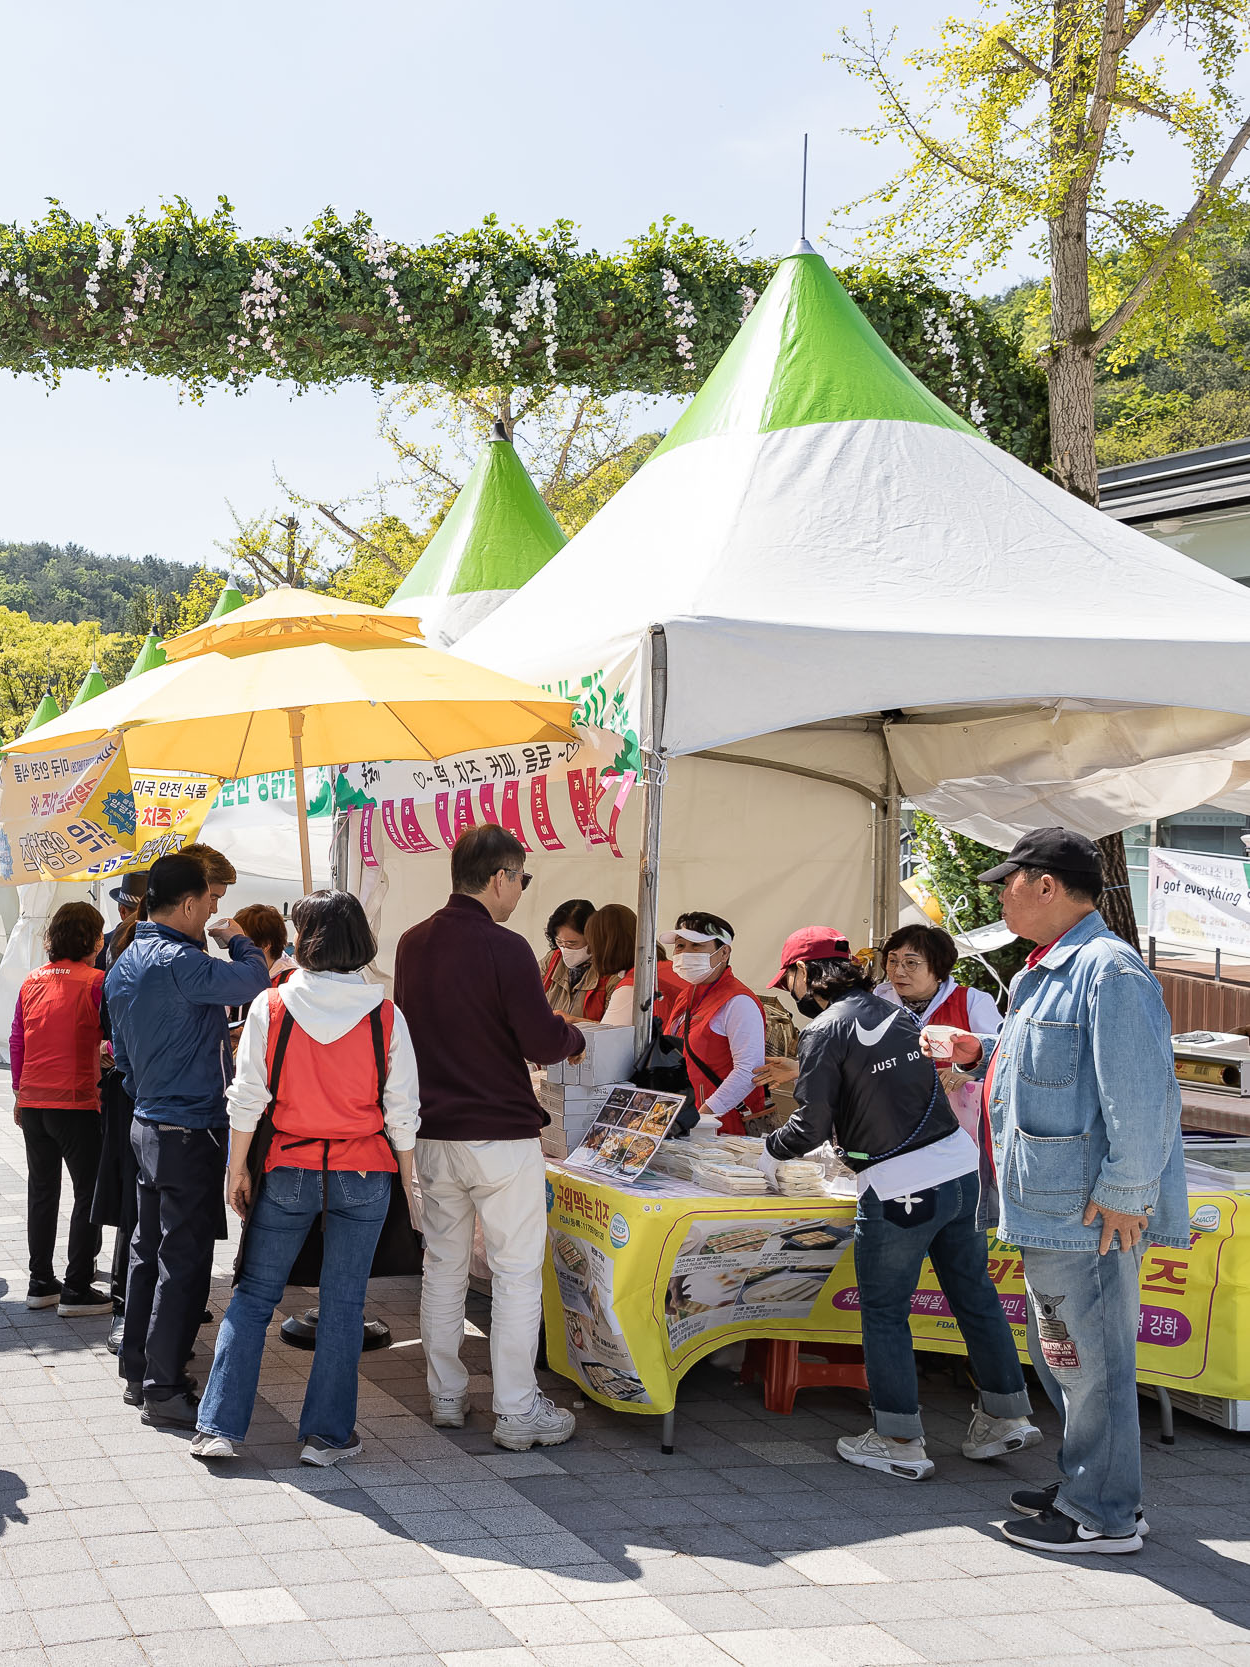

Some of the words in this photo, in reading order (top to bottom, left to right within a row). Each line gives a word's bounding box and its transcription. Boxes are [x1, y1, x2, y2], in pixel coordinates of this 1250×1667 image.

[454, 760, 486, 785] 치즈,
[486, 752, 521, 779] 커피,
[522, 744, 552, 774] 음료
[133, 780, 156, 796] 미국
[159, 782, 182, 798] 안전
[184, 784, 208, 799] 식품
[141, 806, 172, 827] 치즈
[535, 783, 550, 836] 치즈구이
[1155, 875, 1160, 889] I
[1163, 880, 1181, 895] got
[1184, 884, 1242, 907] everything
[871, 1057, 897, 1074] JUST
[906, 1050, 920, 1062] DO
[557, 1184, 593, 1221] 구워먹는
[594, 1197, 610, 1230] 치즈
[1194, 1214, 1218, 1224] HACCP
[1141, 1256, 1189, 1296] 즈
[1150, 1313, 1179, 1339] 강화
